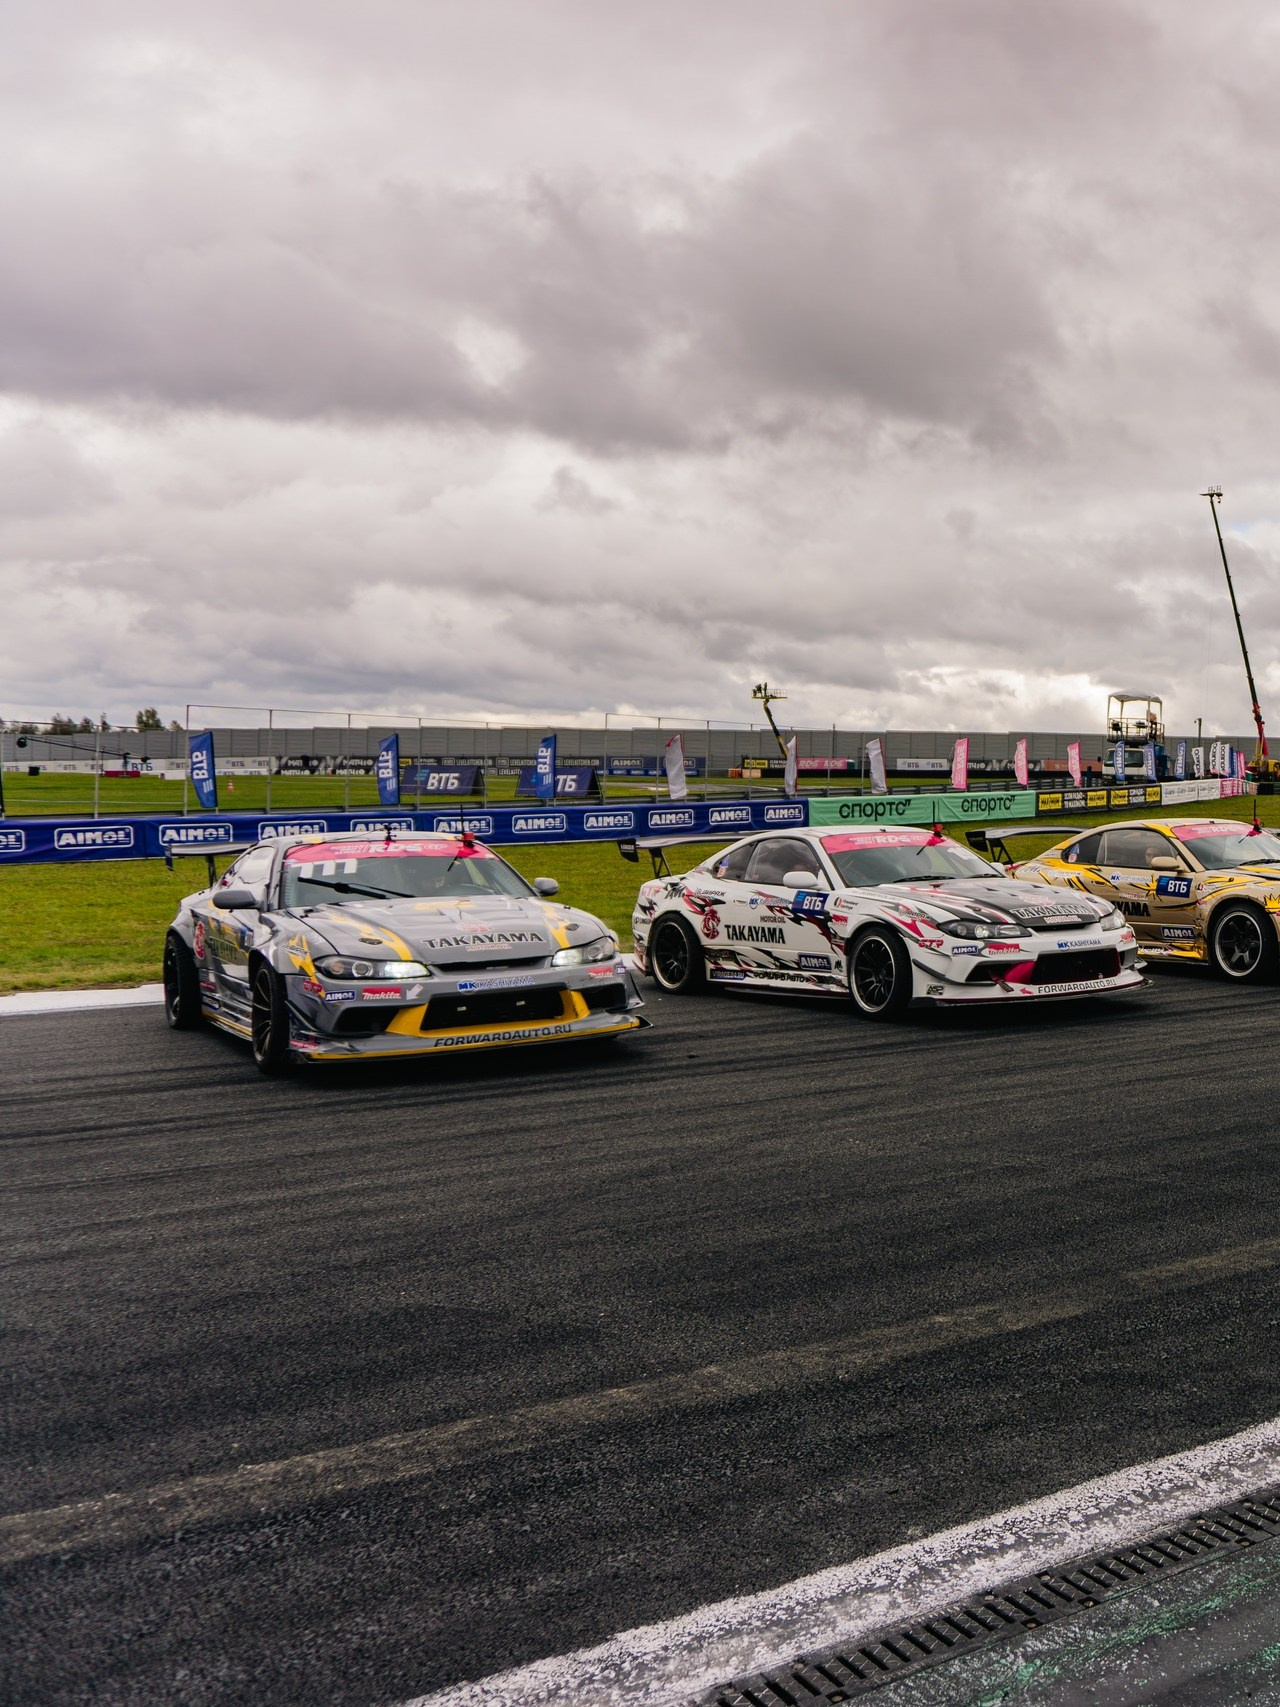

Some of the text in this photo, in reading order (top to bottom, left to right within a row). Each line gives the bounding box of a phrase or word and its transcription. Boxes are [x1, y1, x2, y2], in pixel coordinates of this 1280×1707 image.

[132, 763, 152, 771] ВТБ
[427, 773, 459, 789] ВТБ
[556, 775, 577, 792] ТБ
[651, 812, 691, 824] AIMOL
[711, 809, 749, 821] AIMOL
[766, 807, 800, 819] AIMOL
[515, 818, 563, 830] AIMOL
[586, 815, 631, 827] AIMOL
[59, 831, 129, 845] AIMOL
[163, 828, 229, 840] AIMOL
[875, 836, 910, 844] RDS
[368, 843, 423, 853] RDS
[1167, 880, 1187, 893] ВТБ
[803, 896, 823, 910] ВТБ
[1117, 901, 1150, 917] YAMA
[1010, 904, 1095, 919] TAKAYAMA
[725, 924, 786, 944] TAKAYAMA
[1164, 928, 1193, 937] AIMOL
[423, 931, 545, 949] TAKAYAMA
[1070, 939, 1101, 948] KASHIYAMA
[953, 946, 976, 954] AIMOL
[801, 956, 830, 967] AIMOL
[477, 976, 536, 988] KASHIYAMA
[1038, 979, 1117, 993] FORWARDAUTO.RU
[326, 992, 354, 1001] AIMOL
[362, 991, 401, 1000] makita
[434, 1024, 572, 1047] FORWARDAUTO.RU
